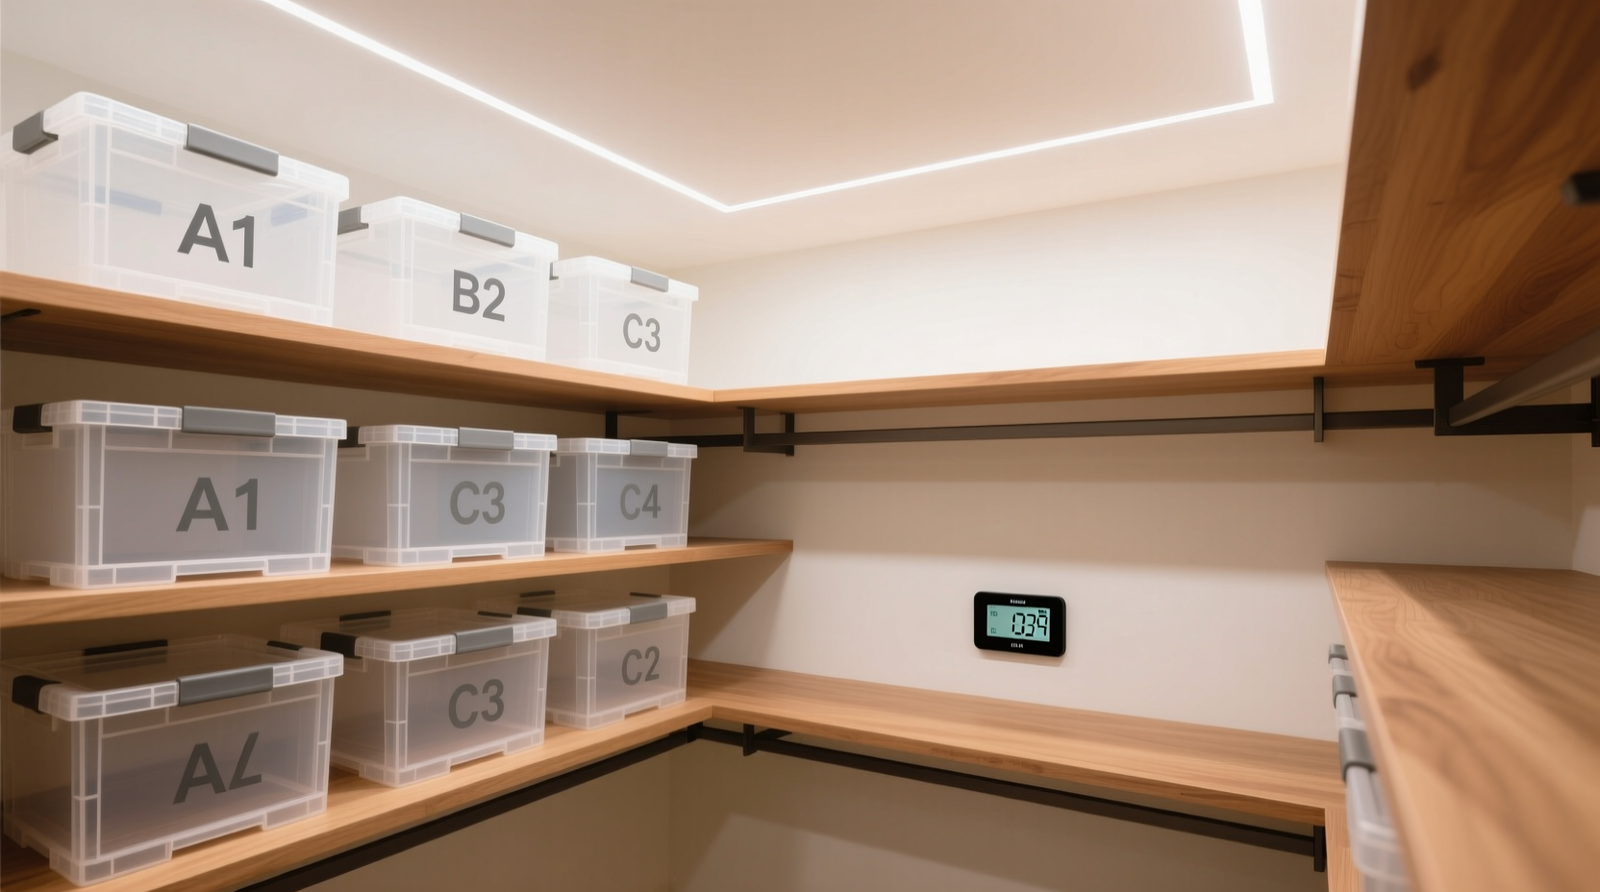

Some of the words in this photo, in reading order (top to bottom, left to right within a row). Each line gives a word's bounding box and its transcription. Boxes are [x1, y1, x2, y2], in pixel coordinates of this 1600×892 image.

[178, 204, 255, 269] A1
[453, 270, 506, 322] B2
[622, 312, 662, 353] C3
[176, 477, 259, 532] A1
[449, 480, 506, 526] C3
[620, 483, 662, 520] C4
[621, 645, 661, 686] C2
[447, 678, 505, 729] C3
